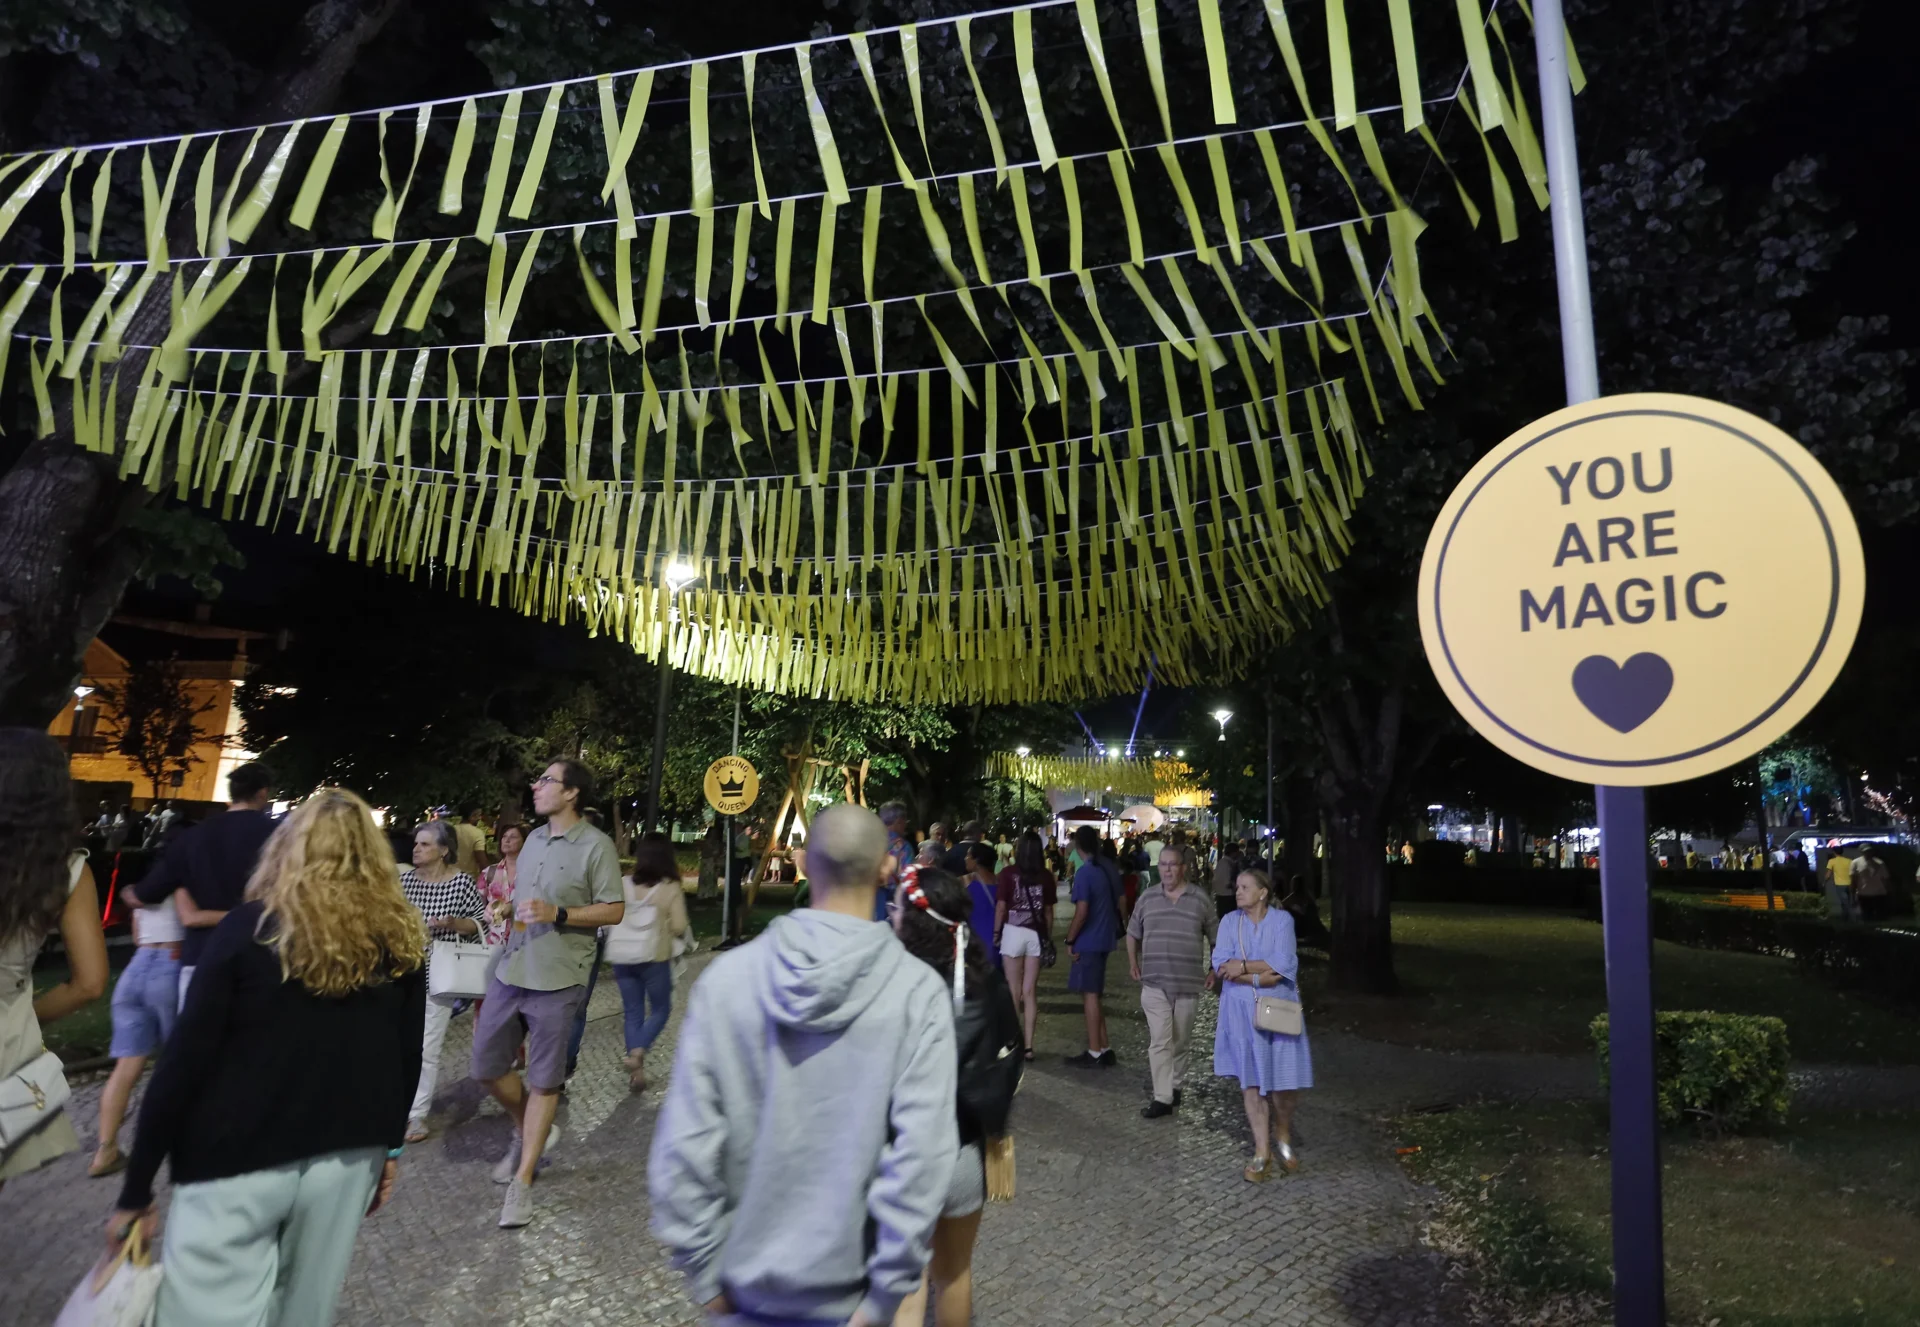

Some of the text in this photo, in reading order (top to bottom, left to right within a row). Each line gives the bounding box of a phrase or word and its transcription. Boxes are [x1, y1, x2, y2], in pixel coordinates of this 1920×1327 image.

[1545, 447, 1673, 505] YOU
[1553, 510, 1678, 567] ARE
[1520, 571, 1727, 632] MAGIC
[712, 758, 749, 774] DANCING
[717, 799, 747, 811] QUEEN
